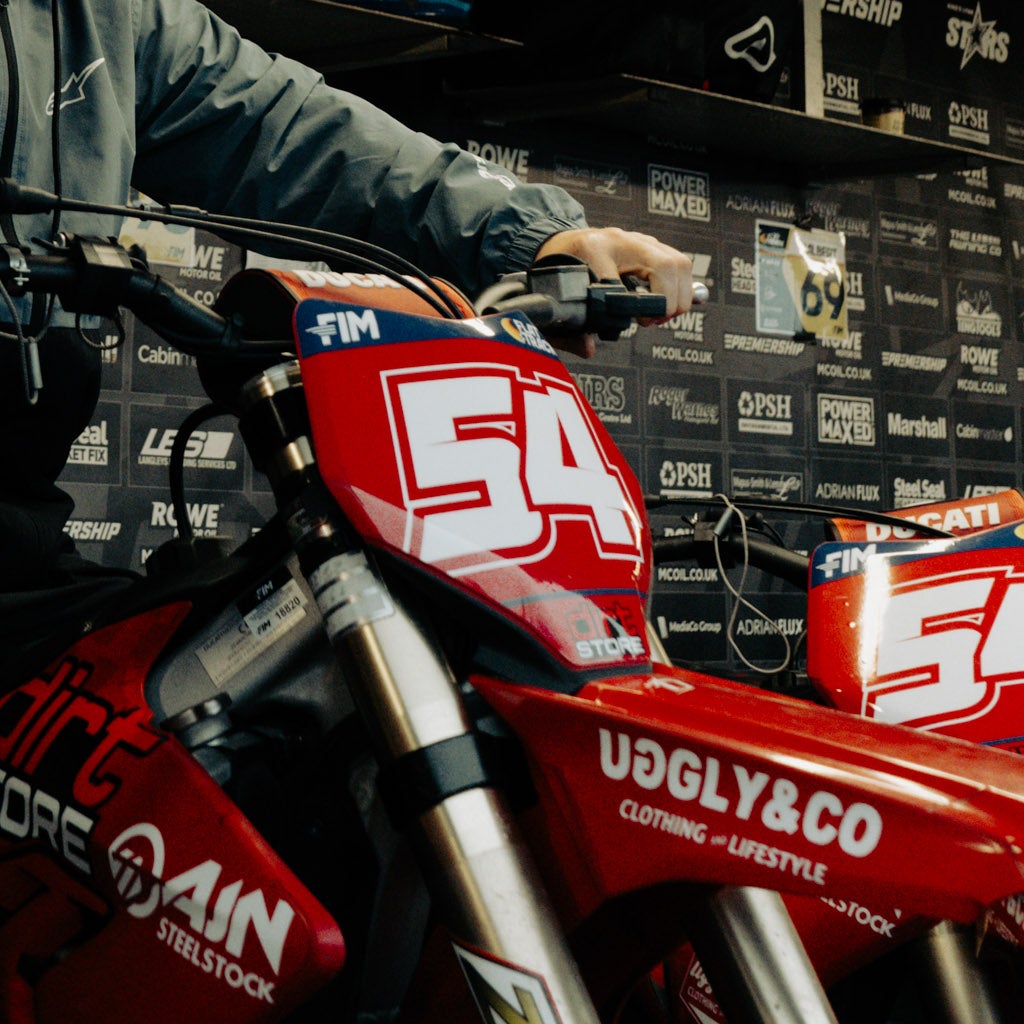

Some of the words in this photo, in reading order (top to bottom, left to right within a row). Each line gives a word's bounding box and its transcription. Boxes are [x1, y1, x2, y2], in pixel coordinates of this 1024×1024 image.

[826, 72, 860, 101] PSH
[961, 104, 989, 131] PSH
[651, 169, 707, 197] POWER
[651, 191, 708, 220] MAXED
[179, 268, 209, 280] MOTOR
[801, 271, 845, 319] 69
[306, 309, 380, 346] FIM
[652, 346, 713, 364] MCOIL.CO.UK
[724, 333, 805, 356] PREMIERSHIP
[960, 344, 999, 366] ROWE
[754, 393, 792, 419] PSH
[821, 400, 871, 421] POWER
[821, 419, 872, 444] MAXED
[888, 412, 947, 439] Marshall
[88, 448, 105, 462] FIX
[385, 375, 638, 563] 54
[676, 462, 712, 488] PSH
[894, 477, 921, 498] Steel
[922, 479, 946, 499] Seal
[866, 501, 1000, 541] DUCATI
[658, 567, 718, 583] MCOIL.CO.UK
[256, 580, 273, 600] FIM
[576, 636, 645, 660] STORE
[619, 799, 709, 845] CLOTHING
[727, 834, 828, 886] LIFESTYLE
[162, 858, 296, 977] AJN
[156, 916, 276, 1005] STEELSTOCK
